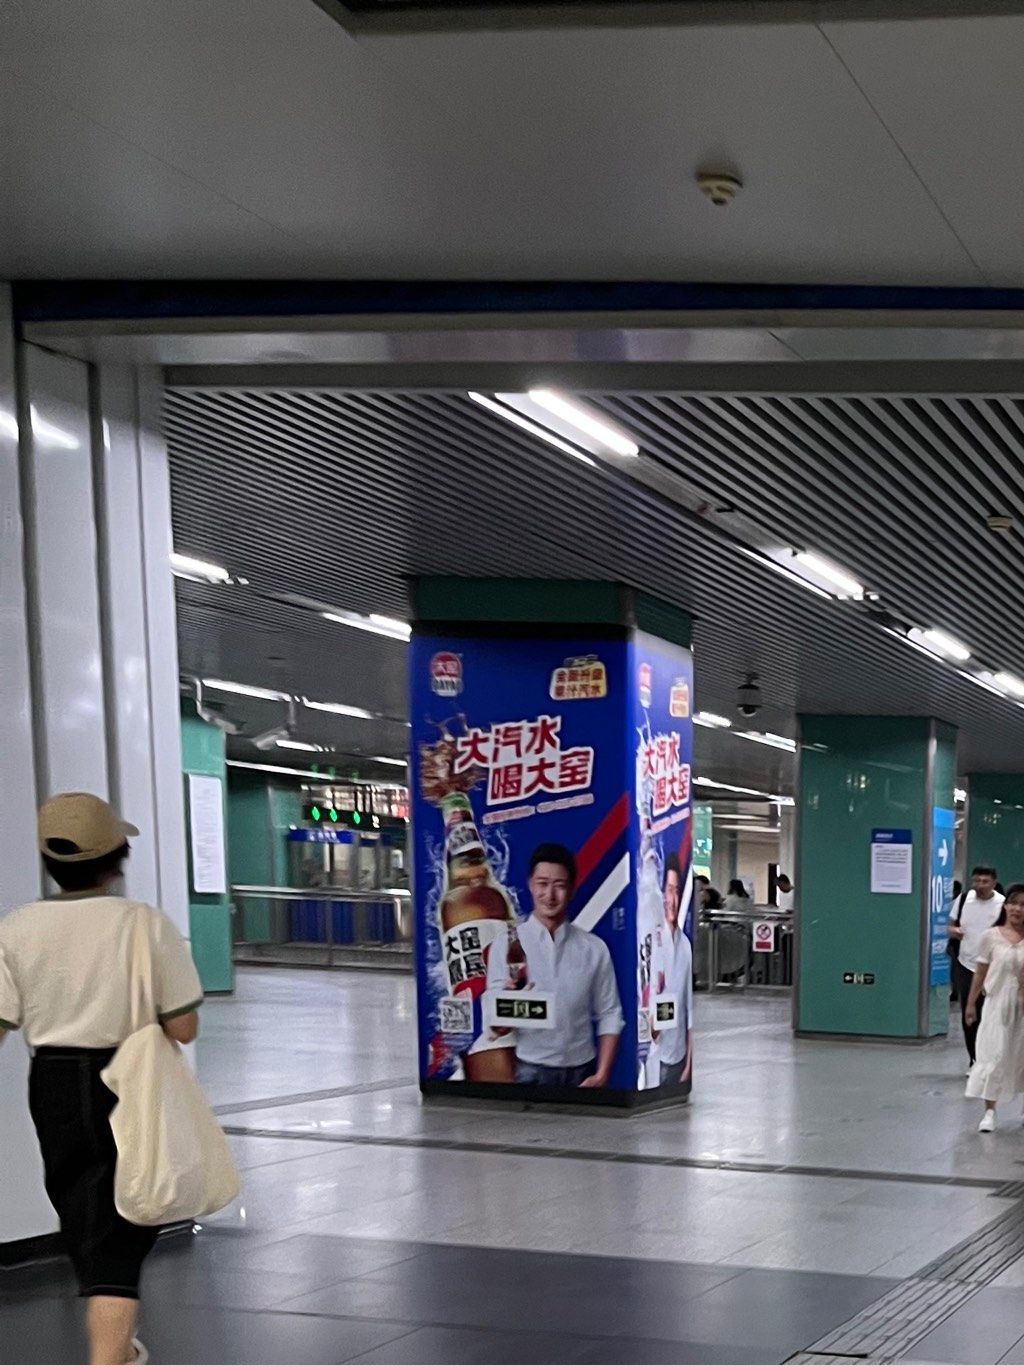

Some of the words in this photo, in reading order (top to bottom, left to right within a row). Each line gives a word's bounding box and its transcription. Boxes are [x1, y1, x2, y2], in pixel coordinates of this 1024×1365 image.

[459, 717, 558, 768] 大汽水
[490, 749, 591, 800] 喝大窑
